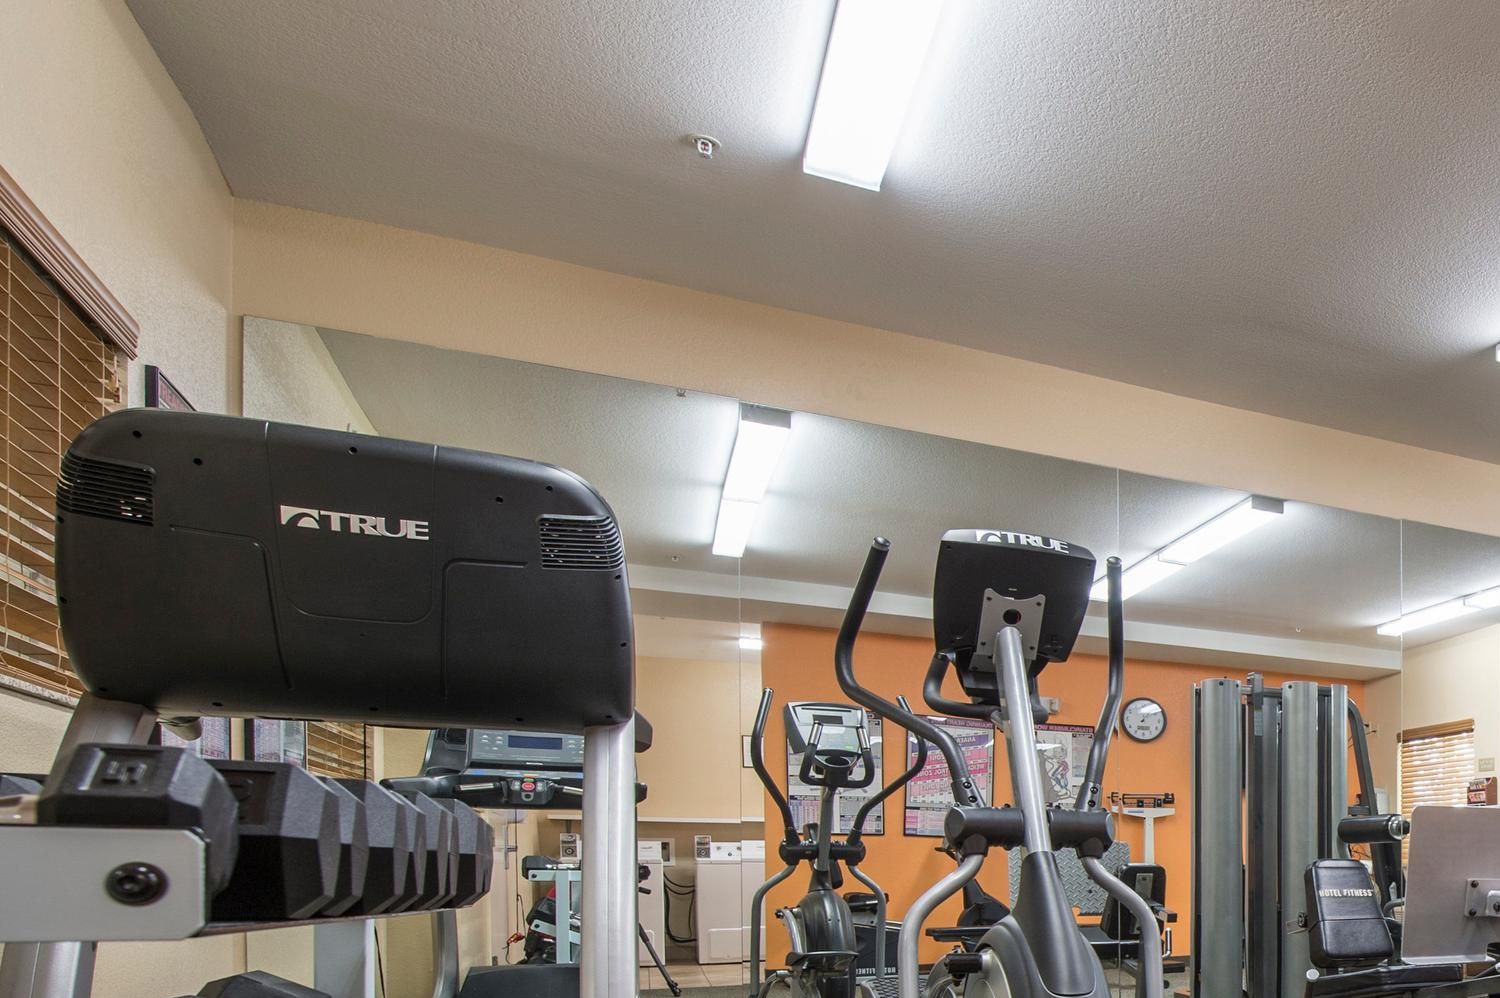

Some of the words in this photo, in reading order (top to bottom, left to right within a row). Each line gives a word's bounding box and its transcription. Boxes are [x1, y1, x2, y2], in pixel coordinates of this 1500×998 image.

[320, 509, 430, 541] TRUE
[1001, 531, 1069, 554] TRUE
[1319, 888, 1342, 897] HOTEL
[1343, 888, 1372, 897] FITNESS
